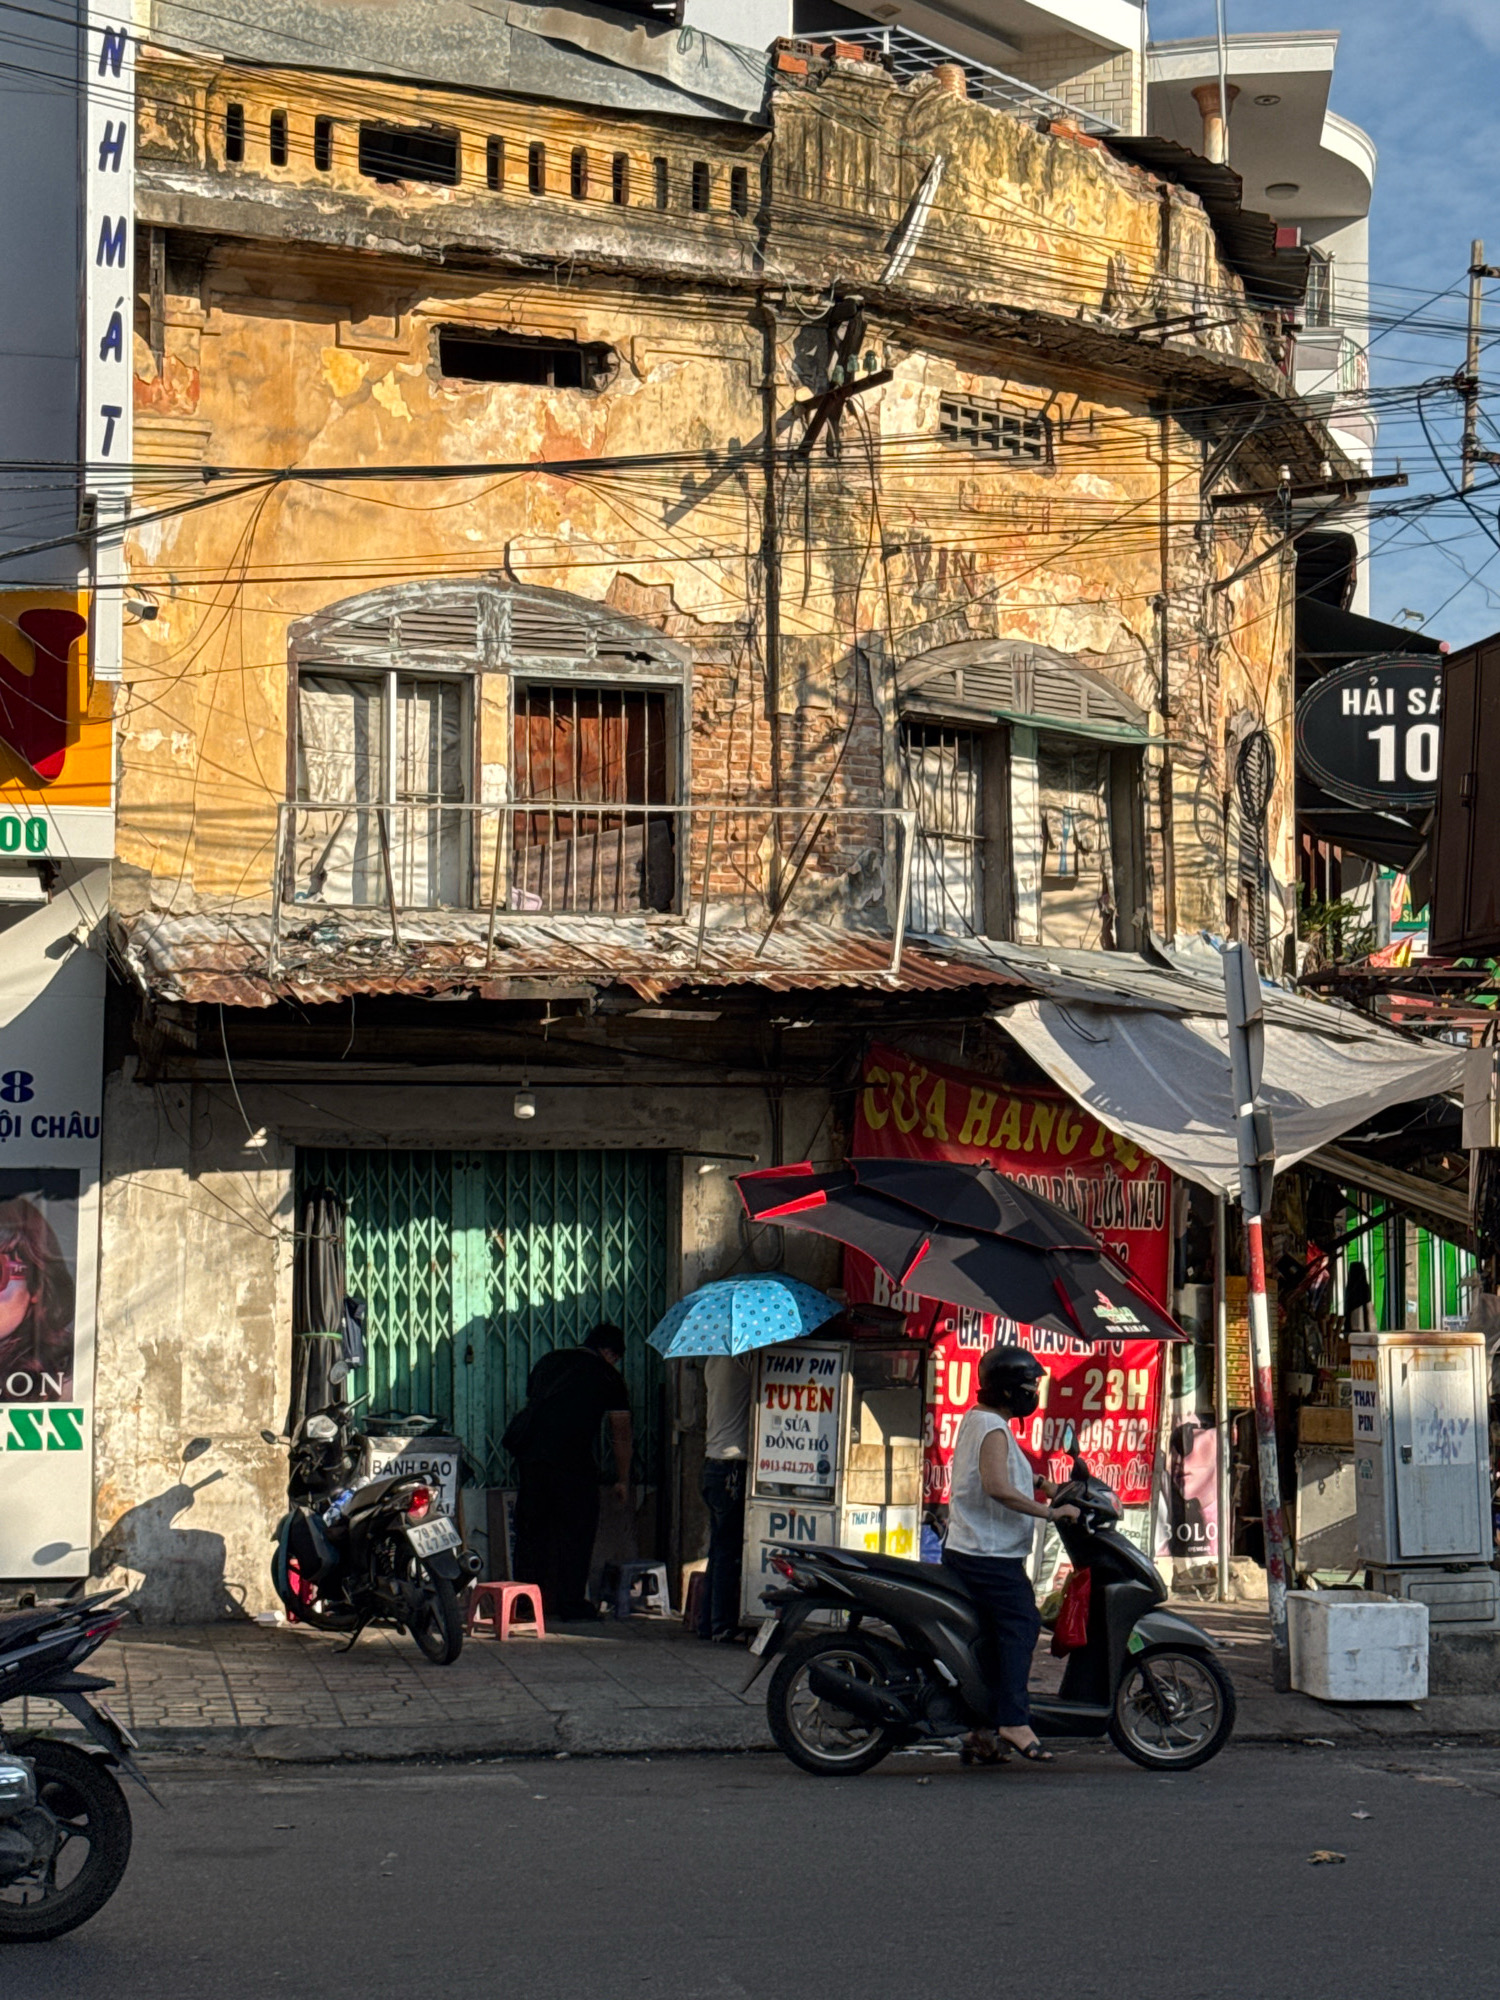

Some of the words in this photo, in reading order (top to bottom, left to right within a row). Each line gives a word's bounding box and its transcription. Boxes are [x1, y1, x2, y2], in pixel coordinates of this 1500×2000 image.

[1342, 675, 1395, 716] HẢI
[31, 1110, 101, 1140] CHÂU
[958, 1084, 1085, 1156] HÀNG
[766, 1355, 805, 1374] THAY
[809, 1358, 836, 1376] PIN
[1082, 1368, 1149, 1412] 23H
[1353, 1389, 1377, 1409] THAY
[1357, 1413, 1374, 1432] PIN
[769, 1510, 816, 1541] PIN
